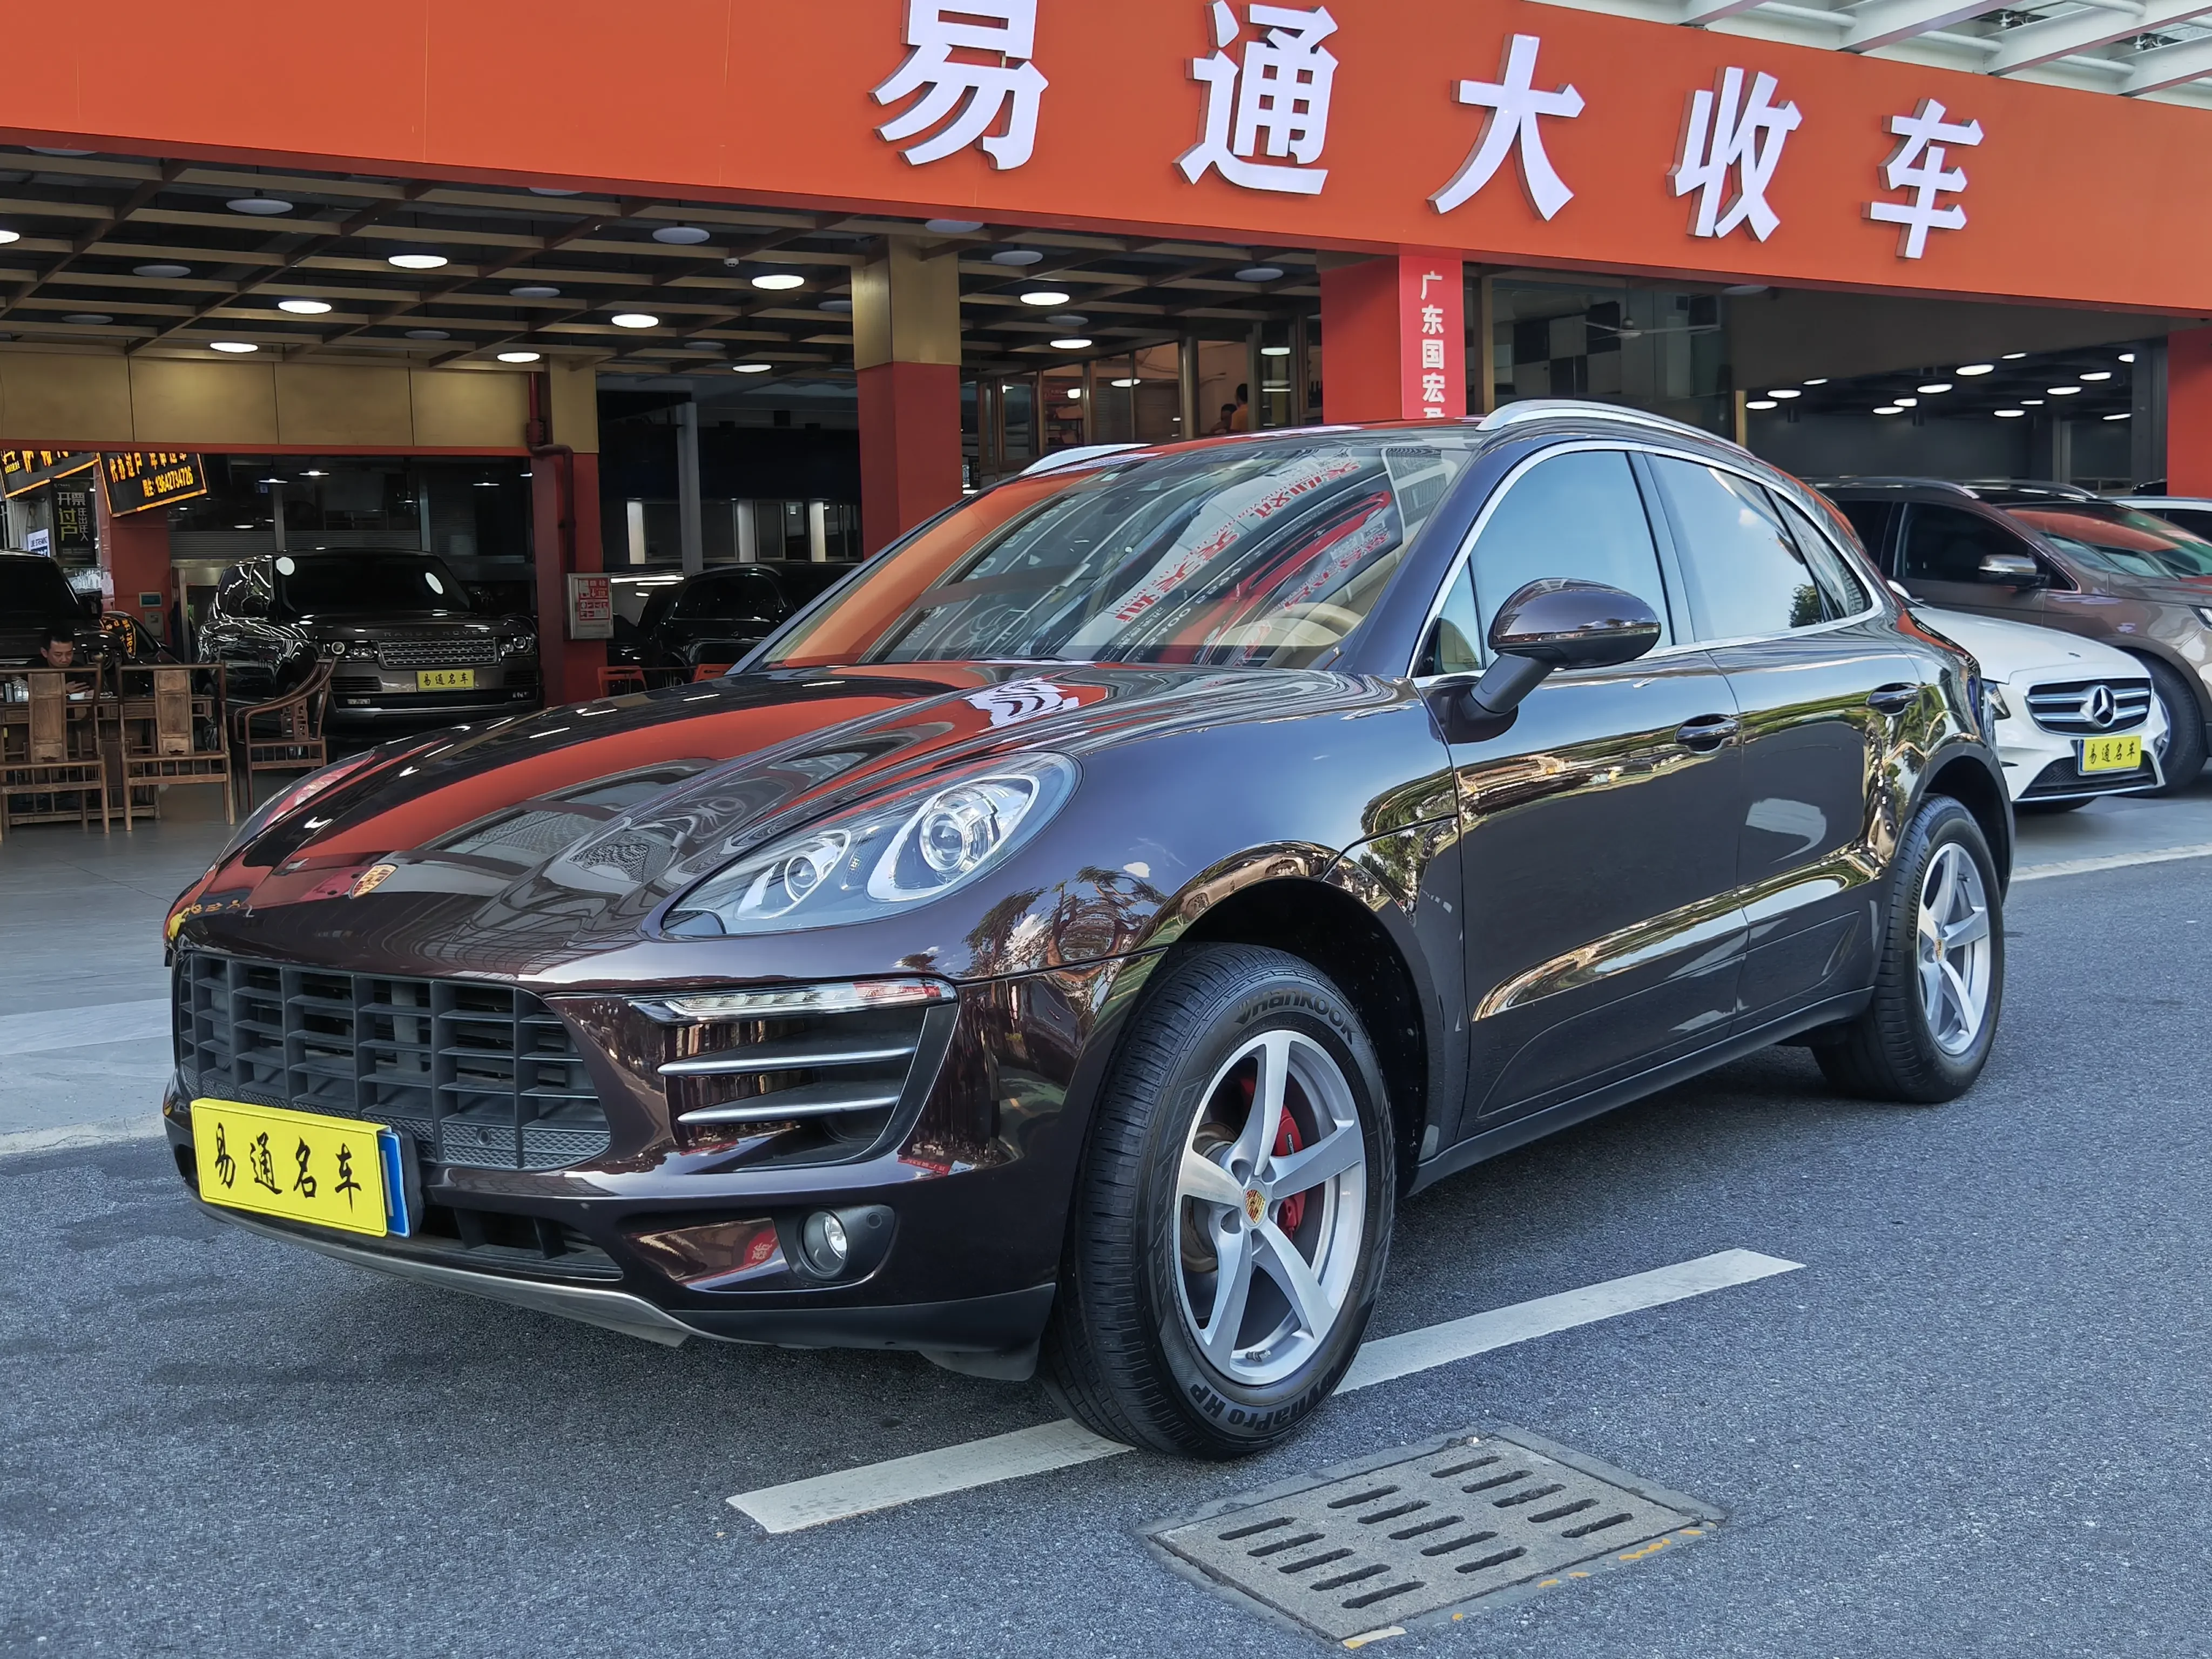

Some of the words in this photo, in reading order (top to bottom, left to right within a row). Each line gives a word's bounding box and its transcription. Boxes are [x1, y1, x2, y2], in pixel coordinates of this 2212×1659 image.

[868, 0, 1985, 259] 易通大收车
[57, 492, 86, 506] 开票
[58, 508, 79, 542] 过户
[423, 672, 469, 686] 易通名车
[2089, 740, 2135, 765] 易通名车
[215, 1122, 362, 1213] 易通名车
